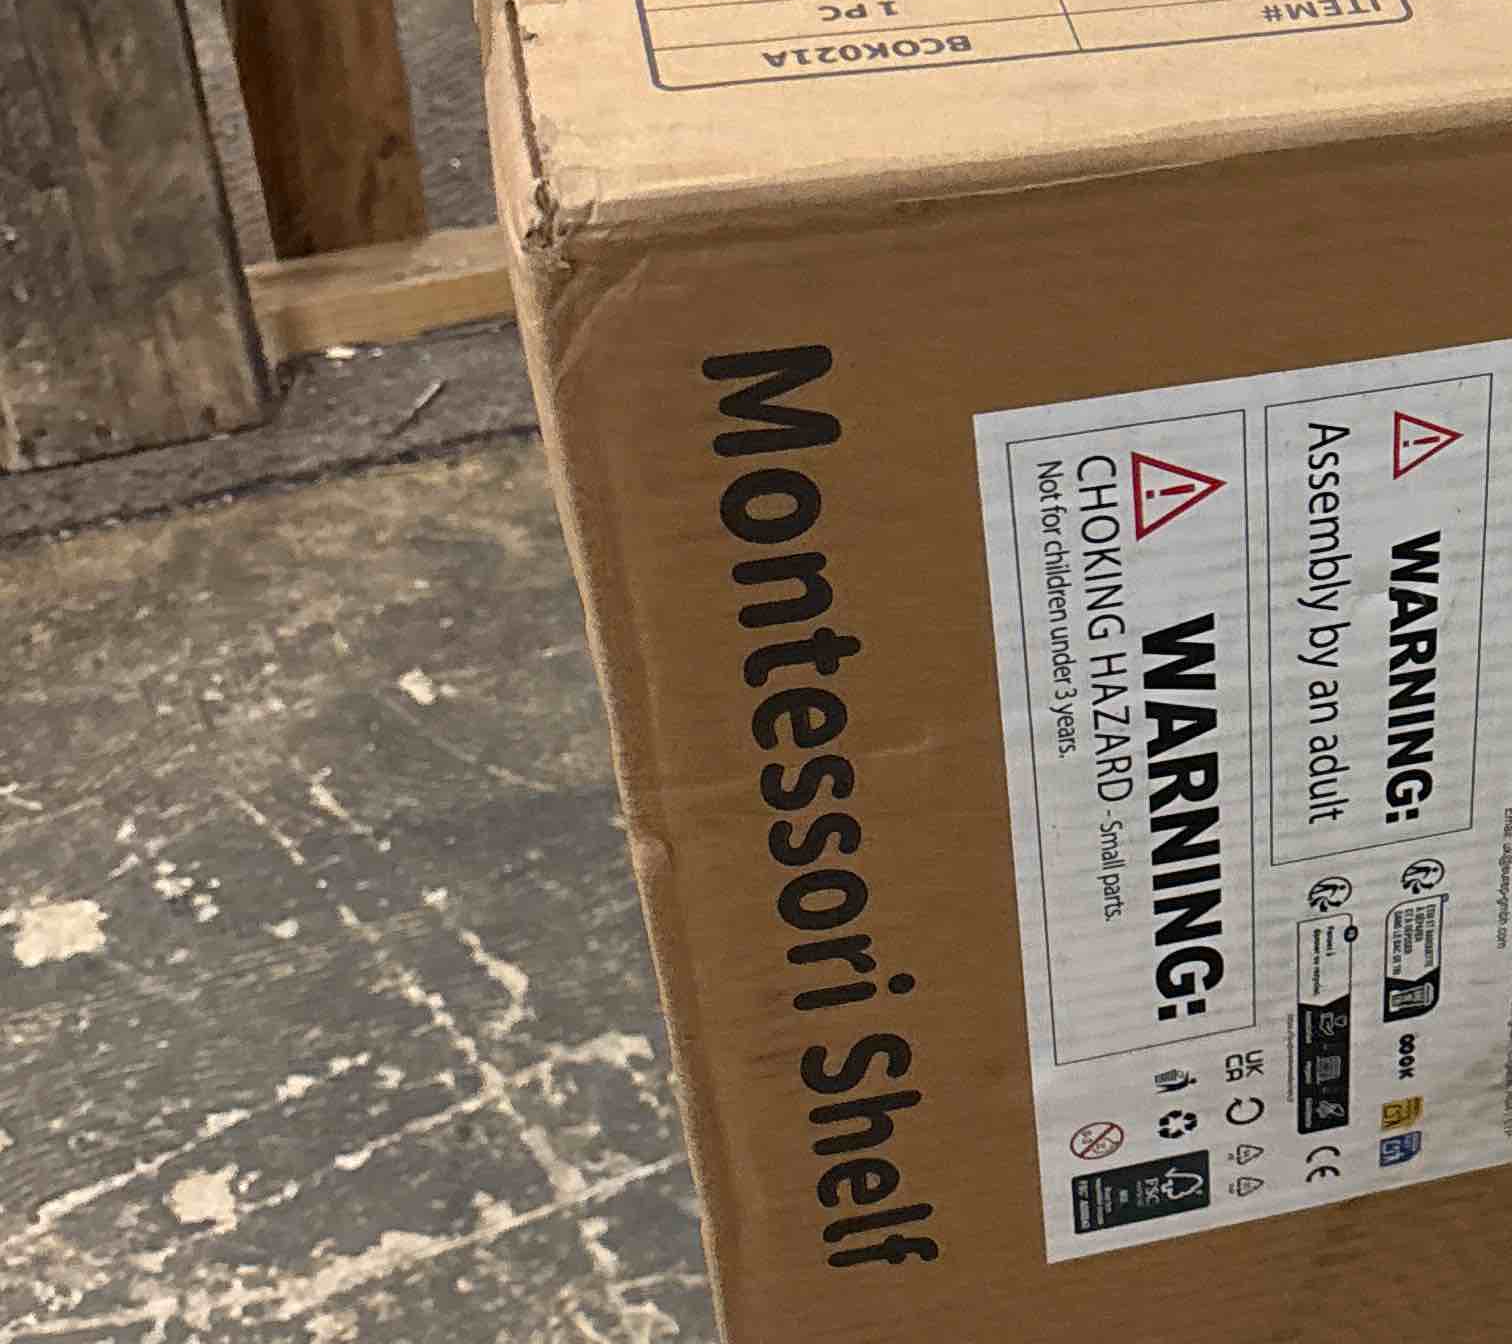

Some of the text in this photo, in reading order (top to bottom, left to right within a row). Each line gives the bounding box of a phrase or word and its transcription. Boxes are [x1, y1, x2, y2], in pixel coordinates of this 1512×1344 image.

[818, 2, 869, 21] PC
[881, 0, 899, 16] 1
[762, 35, 973, 67] BCOK021A
[1036, 459, 1065, 504] Not
[1039, 503, 1067, 538] for
[1075, 452, 1125, 642] CHOKING
[1041, 537, 1072, 624] children
[1296, 416, 1352, 824] Assembly by an adult
[1047, 624, 1076, 686] under
[1384, 529, 1441, 825] WARNING:
[1048, 702, 1077, 761] years.
[1087, 652, 1133, 806] HAZARD
[702, 343, 940, 1269] Montessori Shelf
[1148, 613, 1225, 1022] WARNING:
[1098, 820, 1124, 871] Small
[1096, 871, 1125, 924] parts.
[1225, 1052, 1243, 1083] CA
[1245, 1048, 1263, 1079] UK
[1144, 1177, 1159, 1206] FSC
